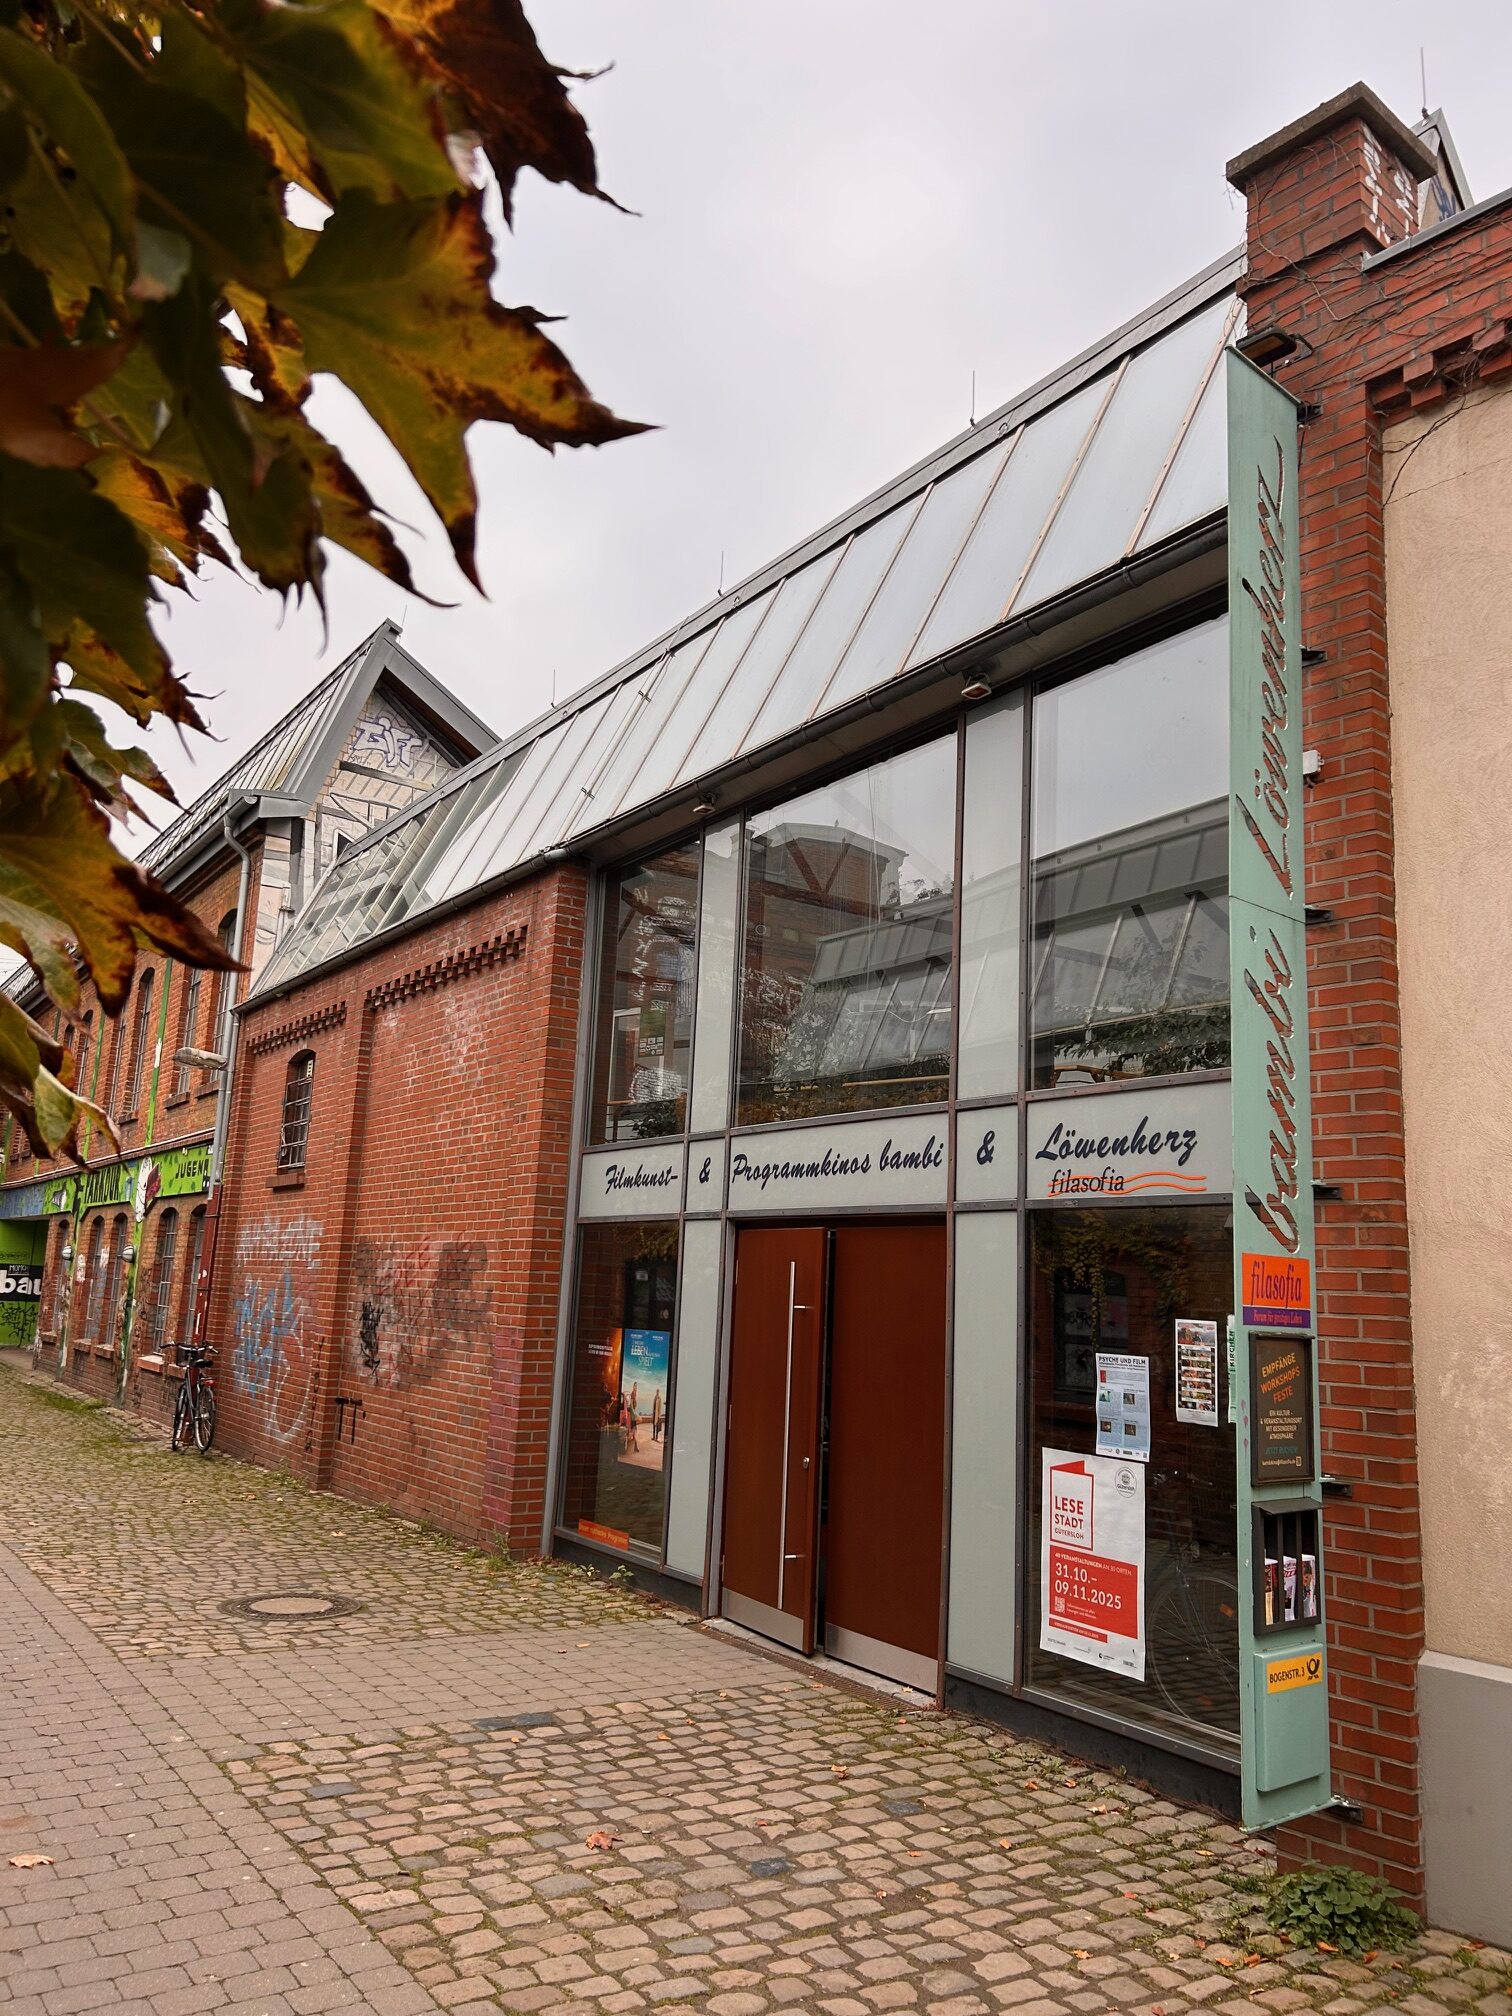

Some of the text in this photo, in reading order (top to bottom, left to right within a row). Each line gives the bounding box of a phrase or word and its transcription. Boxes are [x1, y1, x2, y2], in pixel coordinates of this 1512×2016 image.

[1235, 434, 1294, 900] Löwenherz
[1244, 926, 1300, 1254] bambi
[605, 1115, 1198, 1194] Filmkunst- & Programmkinos bambi & Löwenherz
[175, 1158, 210, 1179] JUGEN
[1050, 1166, 1125, 1194] filasofia
[1251, 1260, 1302, 1308] filasofia
[1261, 1352, 1297, 1378] EMPFÄNGE
[1260, 1365, 1301, 1394] WORKSHOPS
[1273, 1385, 1294, 1404] FESTE
[1055, 1496, 1084, 1516] LESE
[1054, 1527, 1084, 1540] GÜTERSLOH
[1055, 1513, 1084, 1530] STADT
[1061, 1553, 1103, 1571] VERANSTALTUNGEN
[1054, 1579, 1122, 1610] 09.11.2025
[1301, 1666, 1305, 1677] 3
